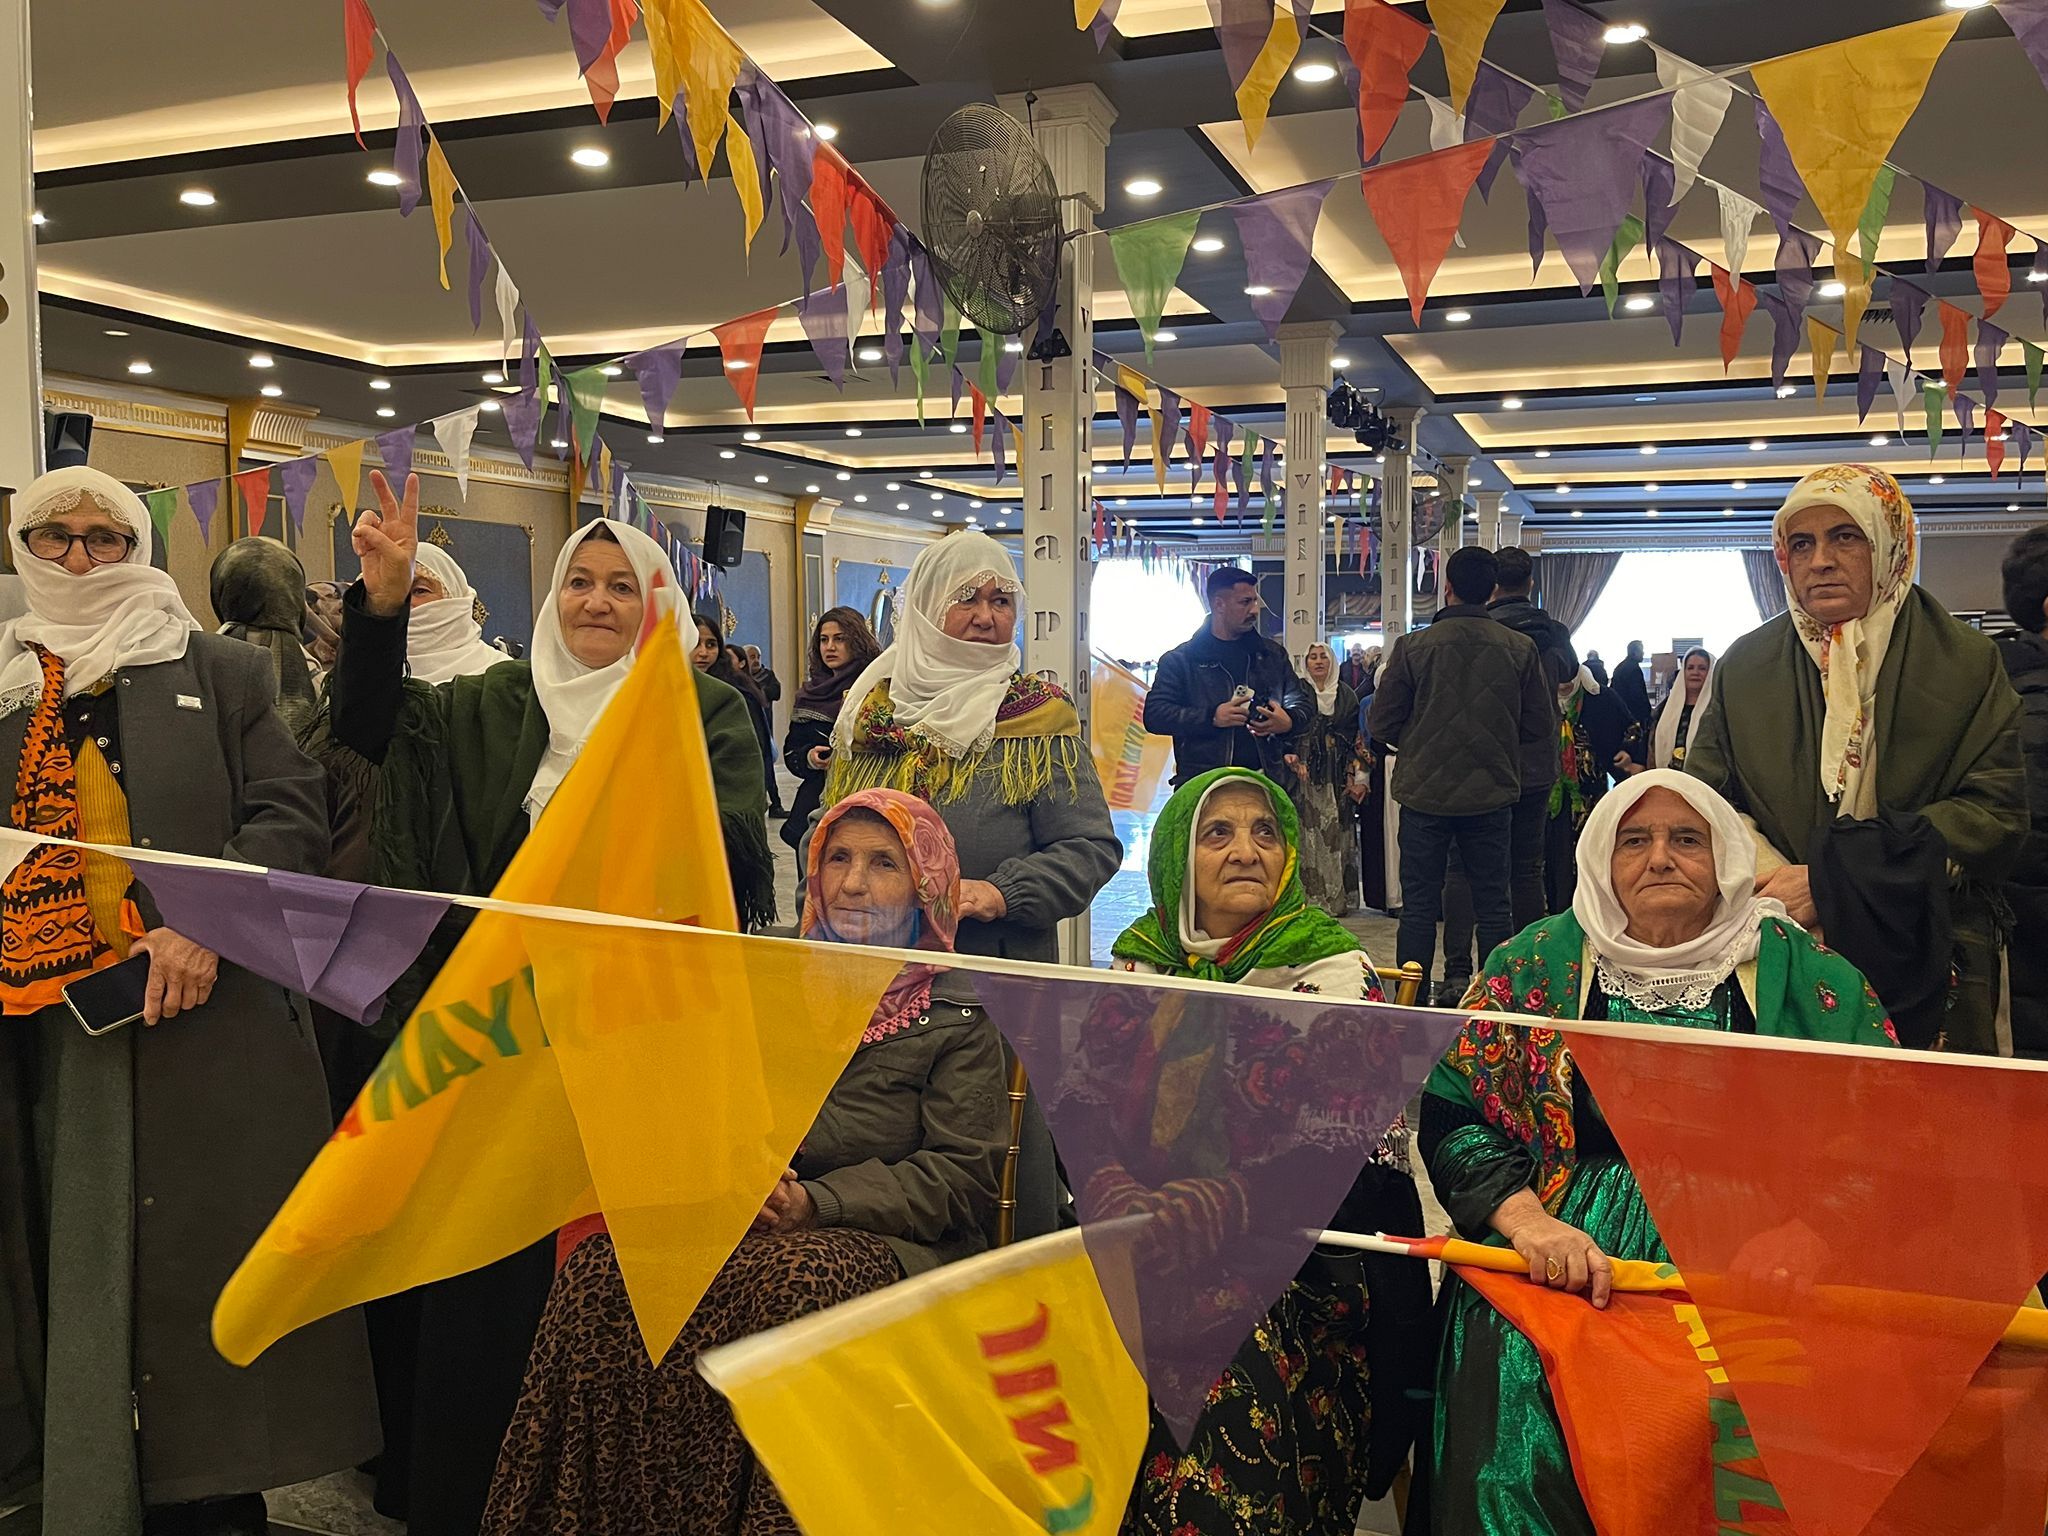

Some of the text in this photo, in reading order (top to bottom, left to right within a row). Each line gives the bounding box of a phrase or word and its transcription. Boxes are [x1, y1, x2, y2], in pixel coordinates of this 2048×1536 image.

[1034, 305, 1061, 562] illa
[1293, 474, 1311, 624] villa
[1387, 521, 1400, 633] villa
